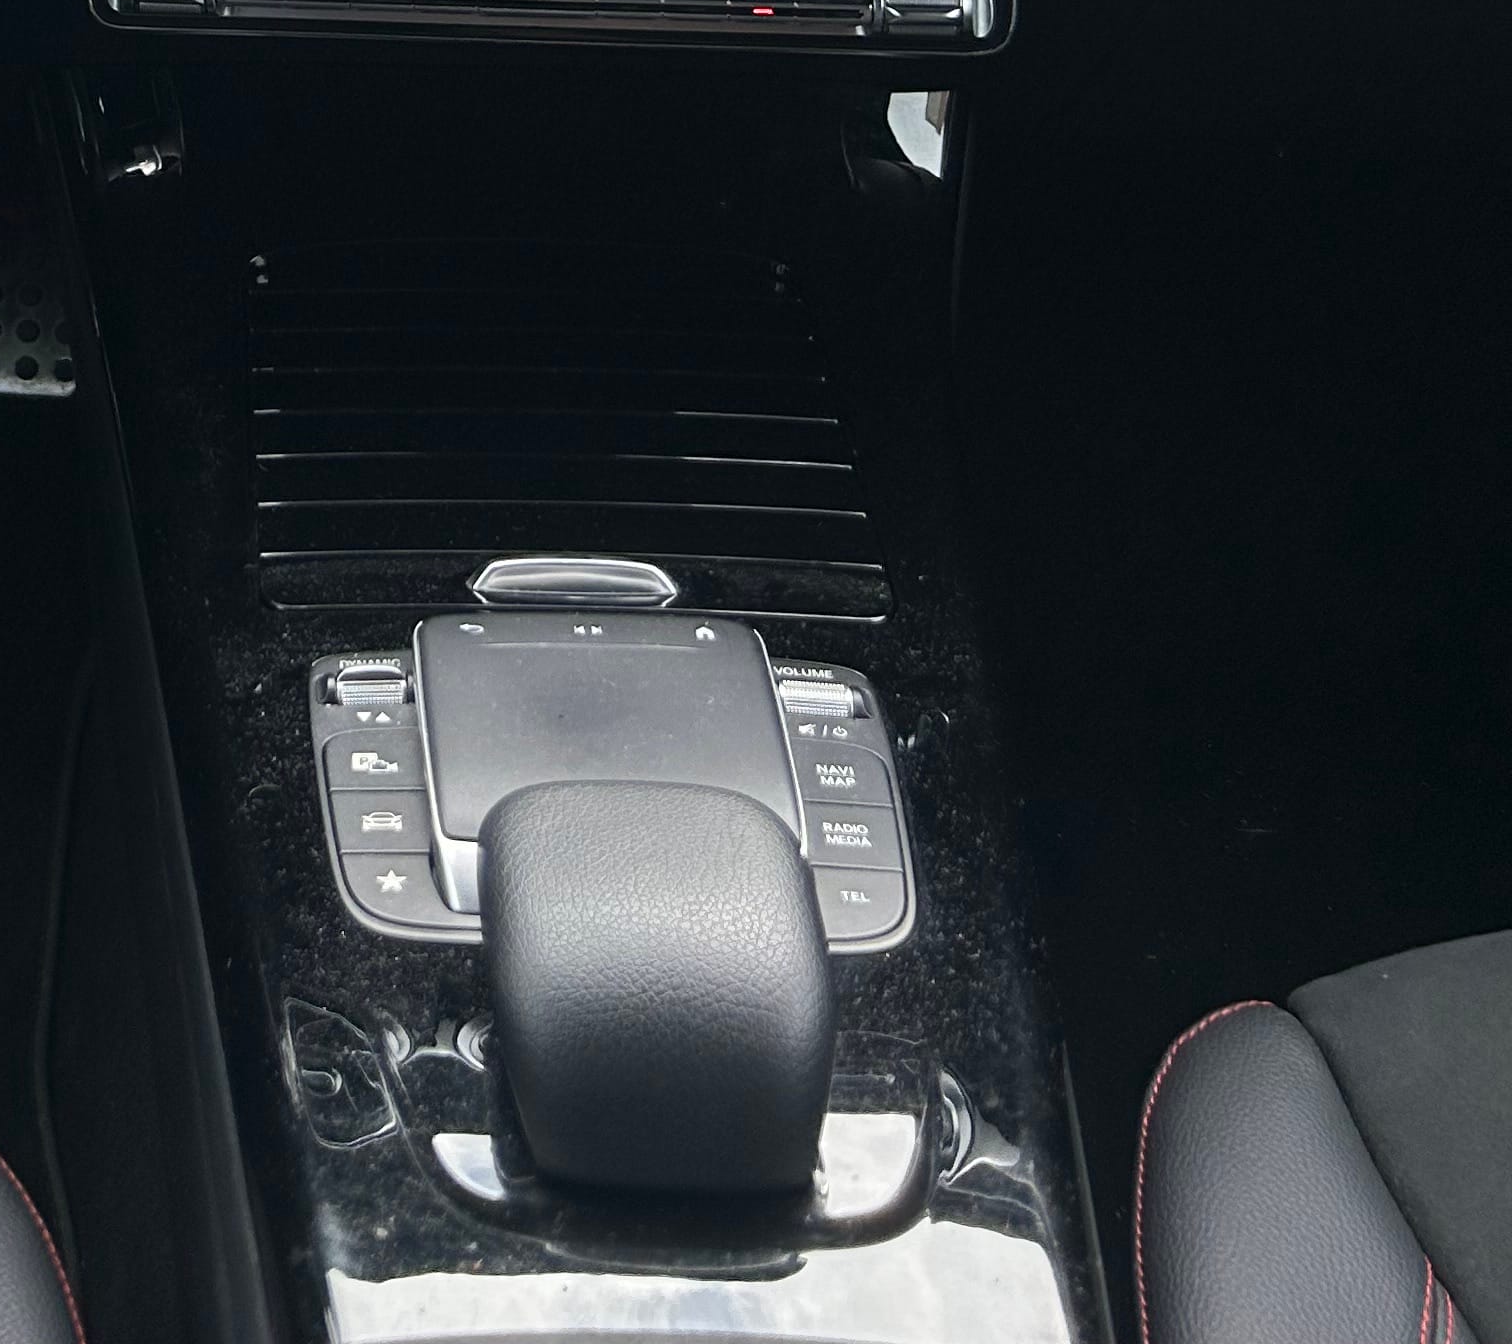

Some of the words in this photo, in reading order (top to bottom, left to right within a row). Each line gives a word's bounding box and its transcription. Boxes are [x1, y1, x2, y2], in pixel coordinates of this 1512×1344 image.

[773, 666, 834, 679] VOLUME
[815, 763, 855, 776] NAVI
[819, 775, 856, 787] MAP
[822, 822, 869, 834] RADIO
[825, 834, 873, 847] MEDIA
[840, 890, 871, 902] TEL
